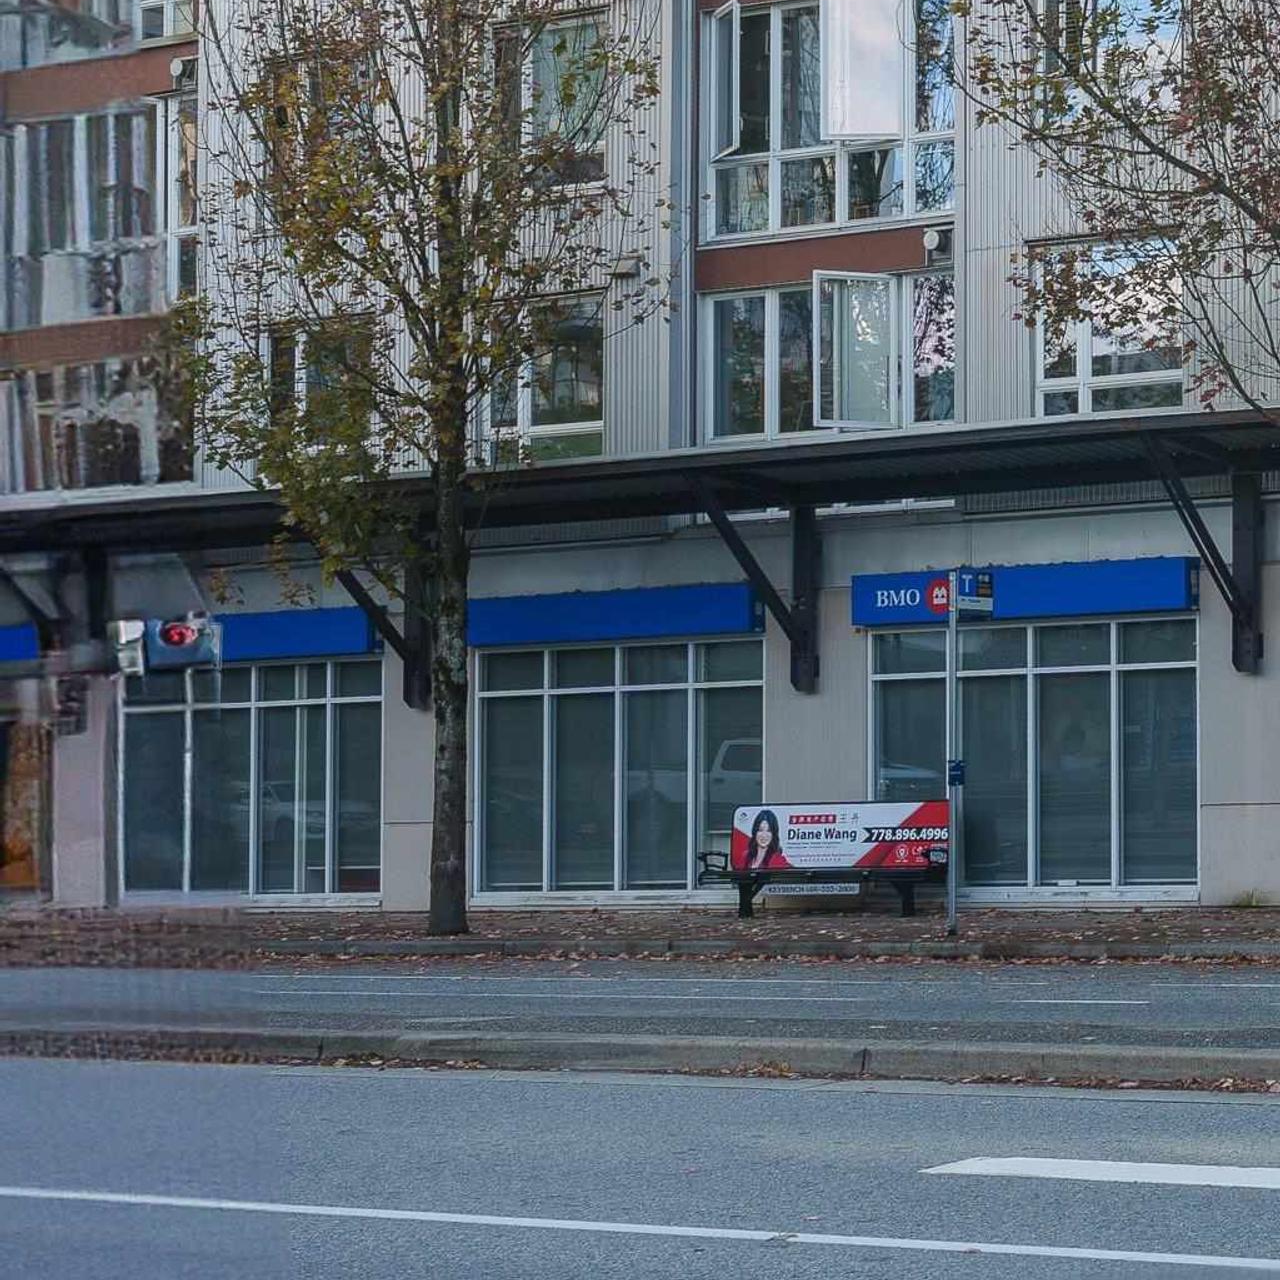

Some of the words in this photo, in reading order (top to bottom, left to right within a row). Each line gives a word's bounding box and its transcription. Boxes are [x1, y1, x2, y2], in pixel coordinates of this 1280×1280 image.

[961, 574, 973, 593] T
[876, 588, 920, 608] BMO
[787, 828, 822, 841] Diane
[824, 827, 858, 843] Wang
[870, 827, 949, 842] 778.896.4996
